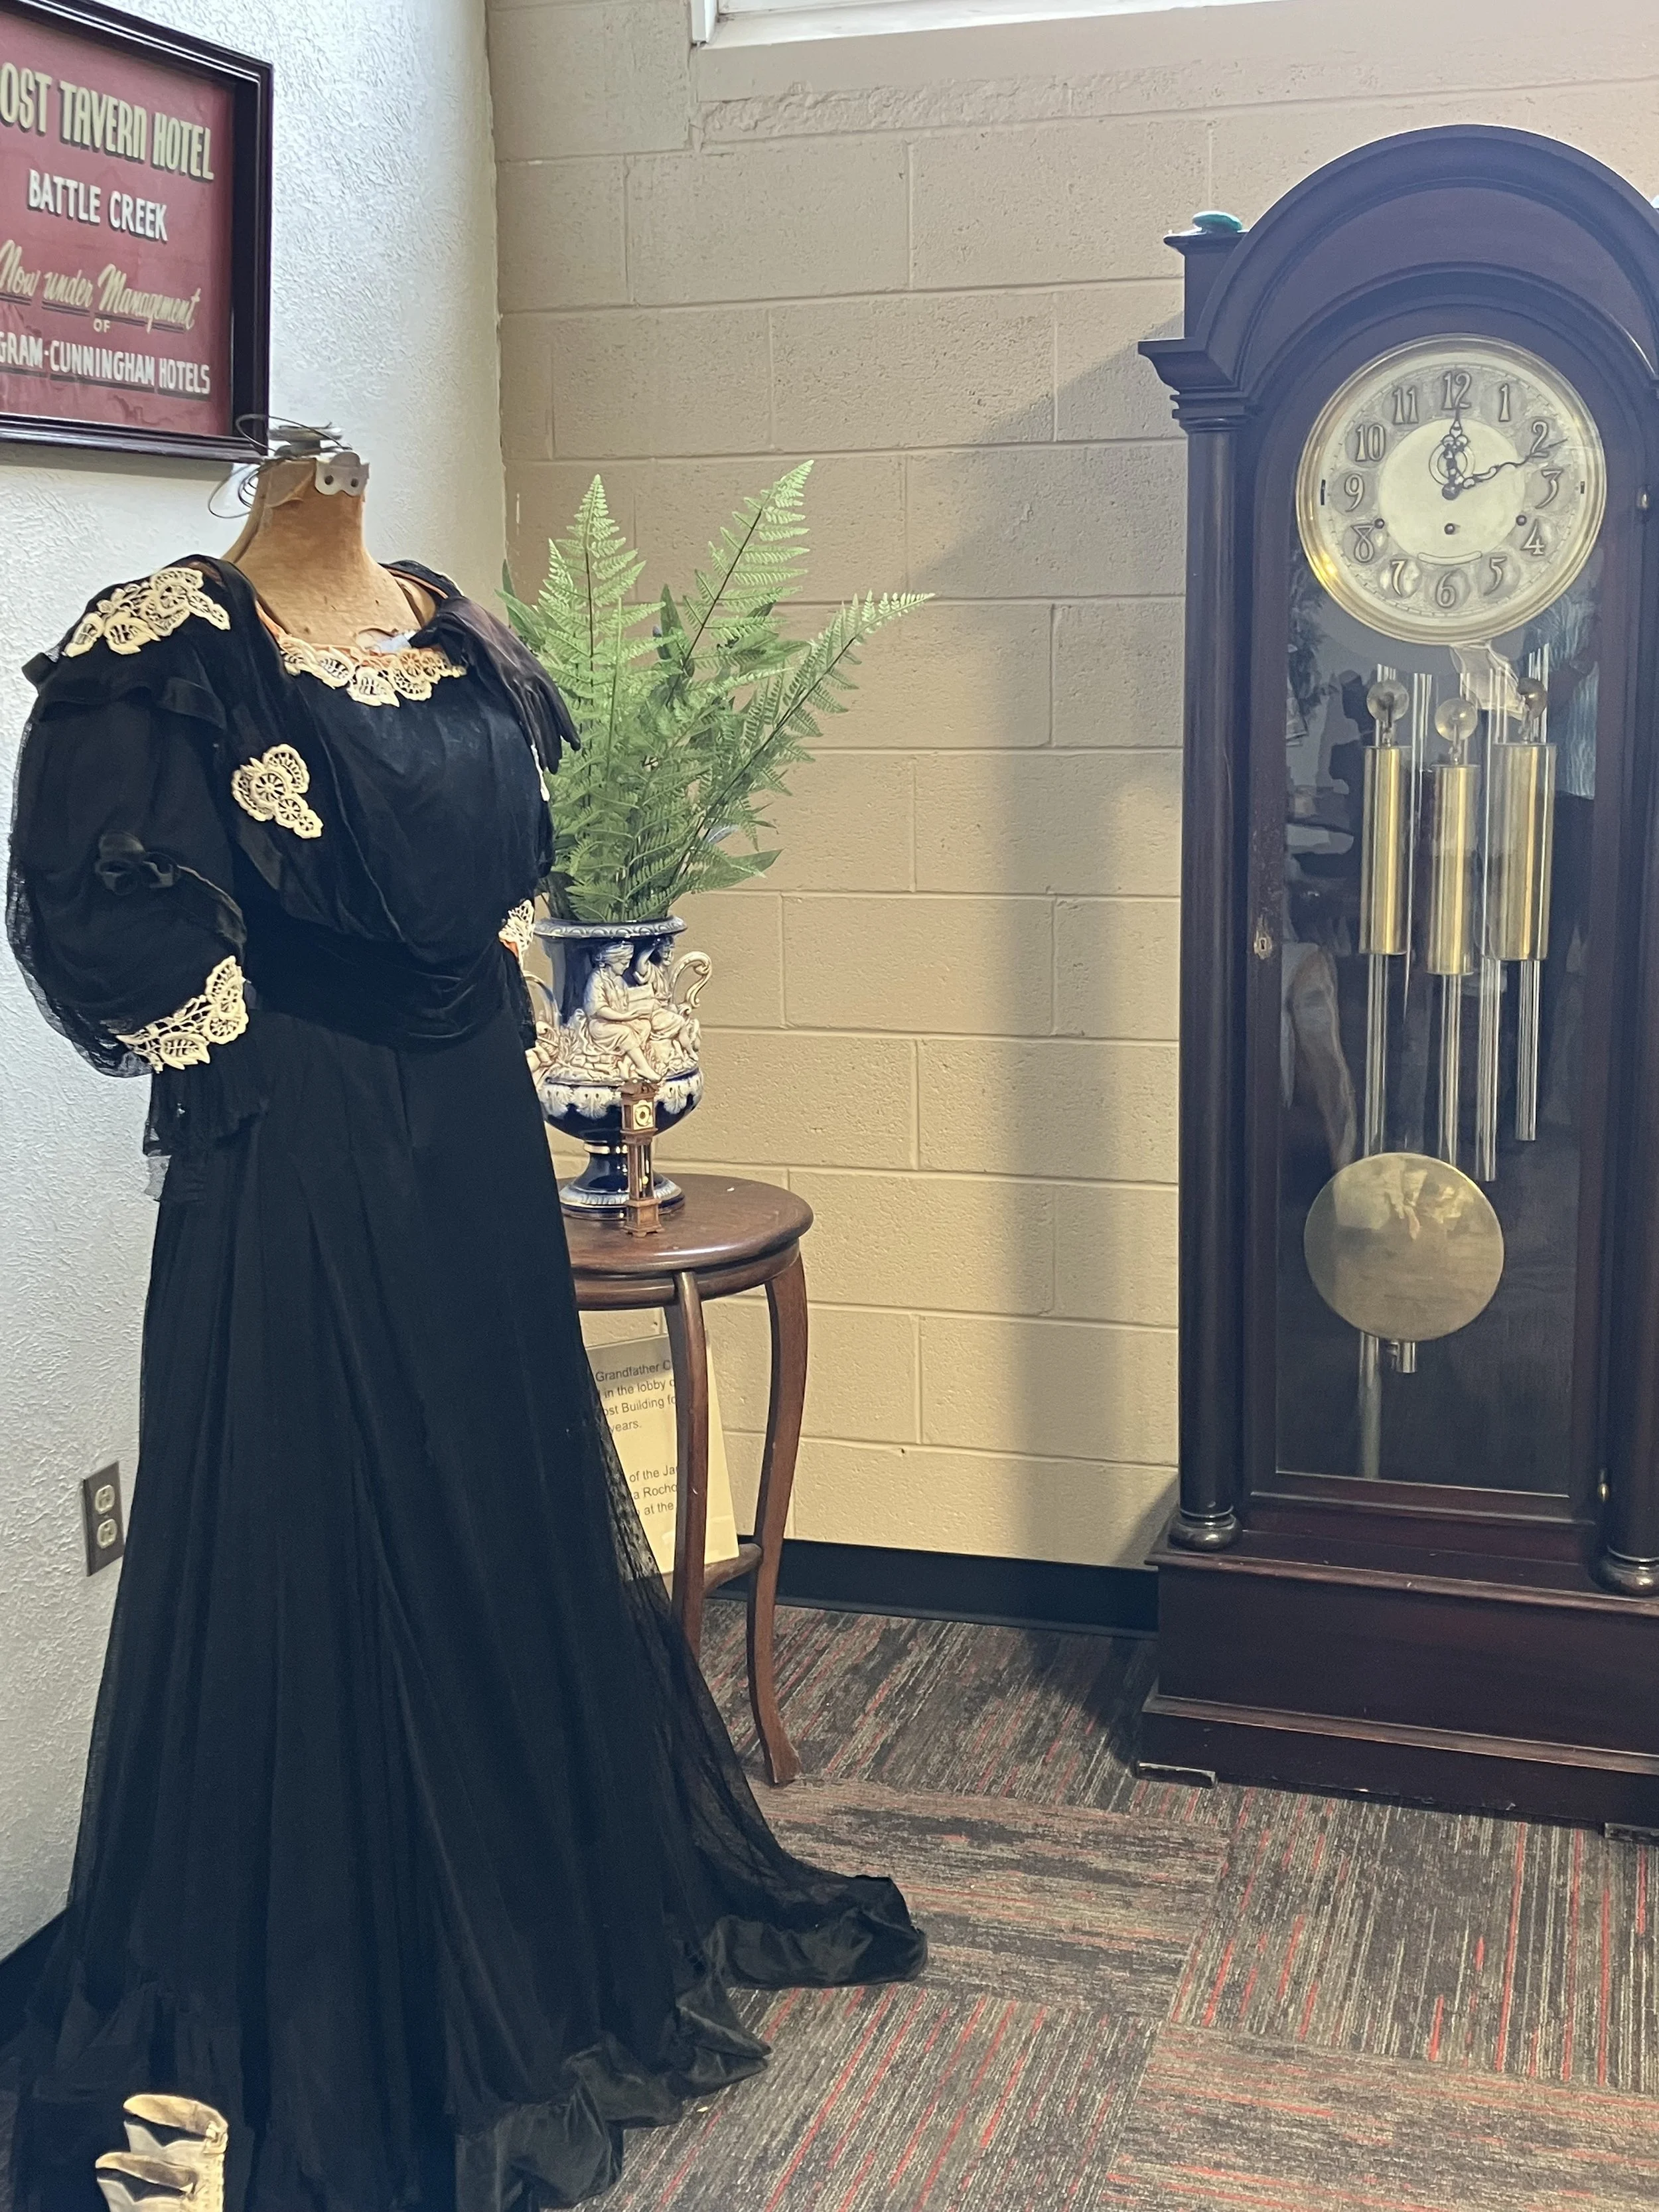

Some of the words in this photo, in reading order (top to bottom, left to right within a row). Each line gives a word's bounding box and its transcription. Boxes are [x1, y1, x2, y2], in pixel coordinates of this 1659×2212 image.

[0, 62, 52, 134] OST
[58, 80, 147, 161] TAVERN
[152, 111, 214, 181] HOTEL
[29, 169, 100, 224] BATTLE
[109, 190, 167, 242] CREEK
[0, 240, 41, 297] Now
[44, 269, 94, 307] under
[98, 263, 201, 332] Management
[94, 318, 110, 332] OF
[159, 358, 210, 394] HOTELS
[1442, 370, 1471, 410] 12
[1394, 386, 1419, 423] 11
[1499, 383, 1510, 421] 1
[1356, 424, 1386, 462] 10
[1531, 421, 1550, 457] 2
[1344, 473, 1365, 512] 9
[1535, 469, 1561, 509] 3
[1351, 523, 1375, 562] 8
[1520, 518, 1545, 555] 4
[1392, 559, 1407, 596] 7
[1437, 569, 1456, 608] 6
[1484, 556, 1507, 596] 5
[595, 1363, 660, 1382] Grandfather
[604, 1390, 614, 1398] in
[617, 1384, 634, 1396] the
[637, 1379, 666, 1393] lobby
[621, 1398, 664, 1413] Building
[629, 1471, 640, 1483] of
[643, 1469, 660, 1480] the
[644, 1503, 655, 1516] at
[657, 1502, 674, 1513] the
